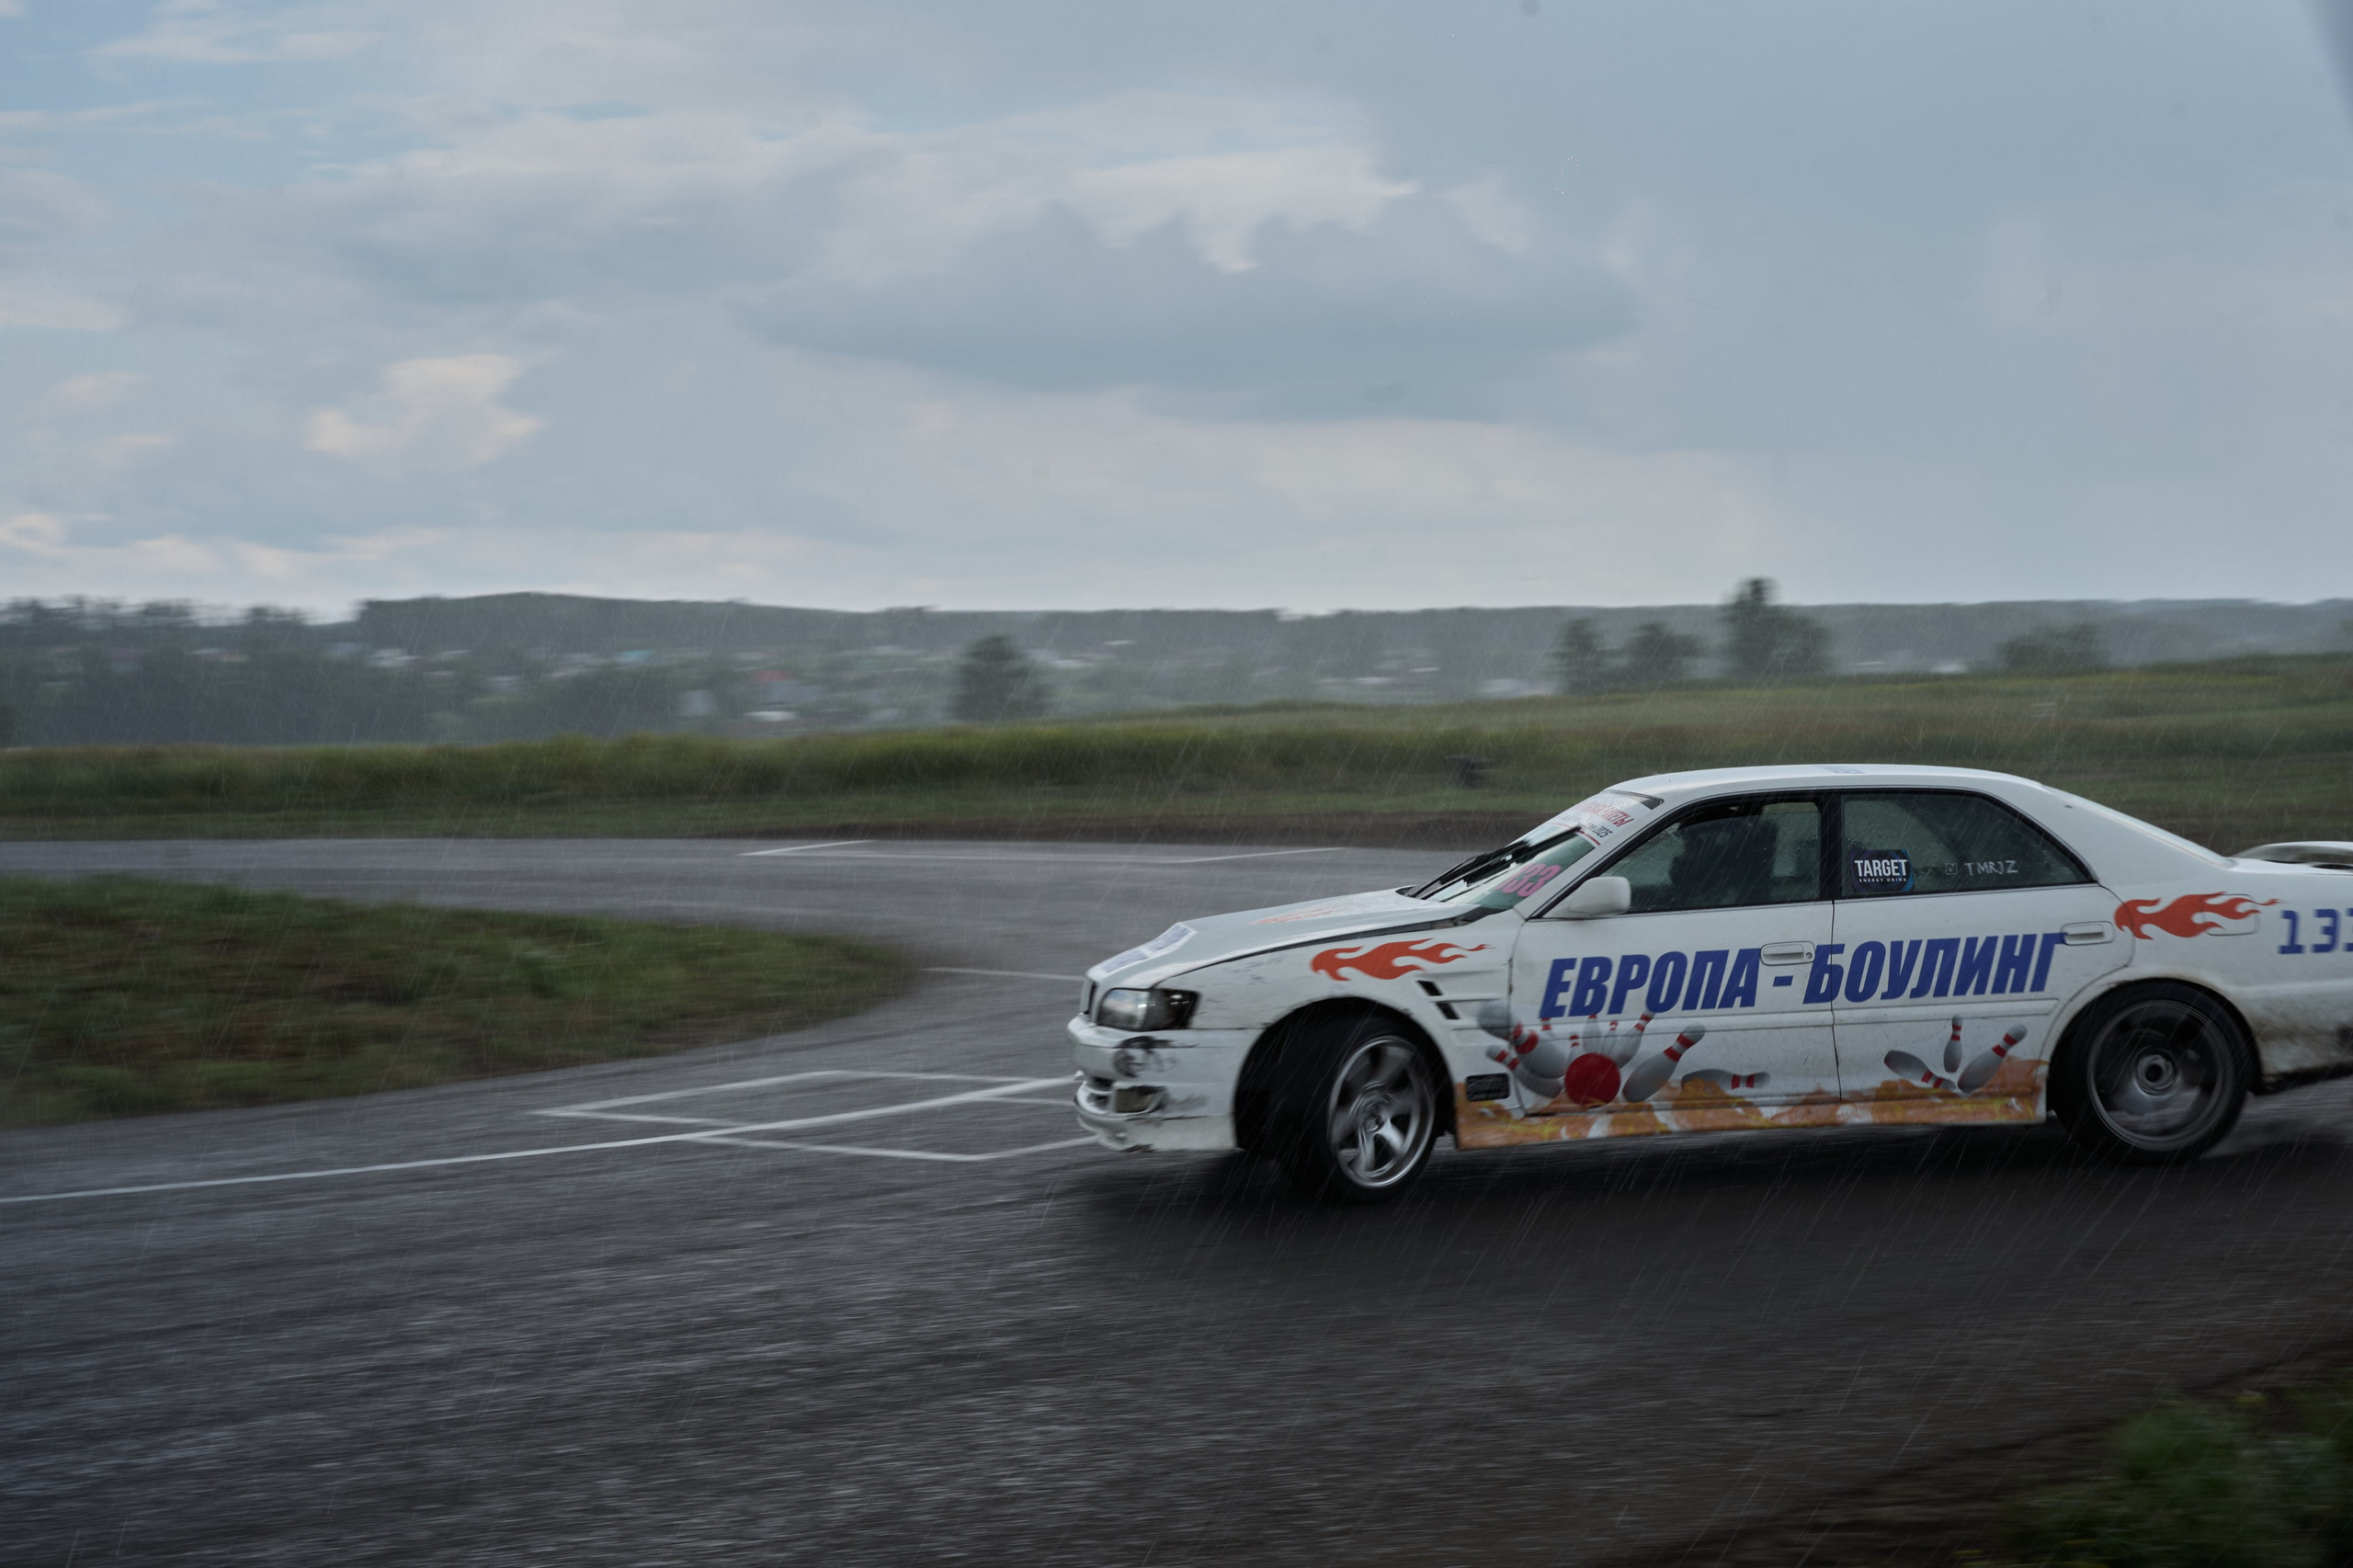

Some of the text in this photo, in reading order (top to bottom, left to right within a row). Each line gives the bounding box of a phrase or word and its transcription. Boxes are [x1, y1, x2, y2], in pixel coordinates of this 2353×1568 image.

[1495, 862, 1562, 897] 133
[1854, 859, 1907, 877] TARGET
[2277, 908, 2353, 954] 13
[1539, 947, 1761, 1018] ЕВРОПА
[1802, 932, 2065, 1005] БОУЛИНГ
